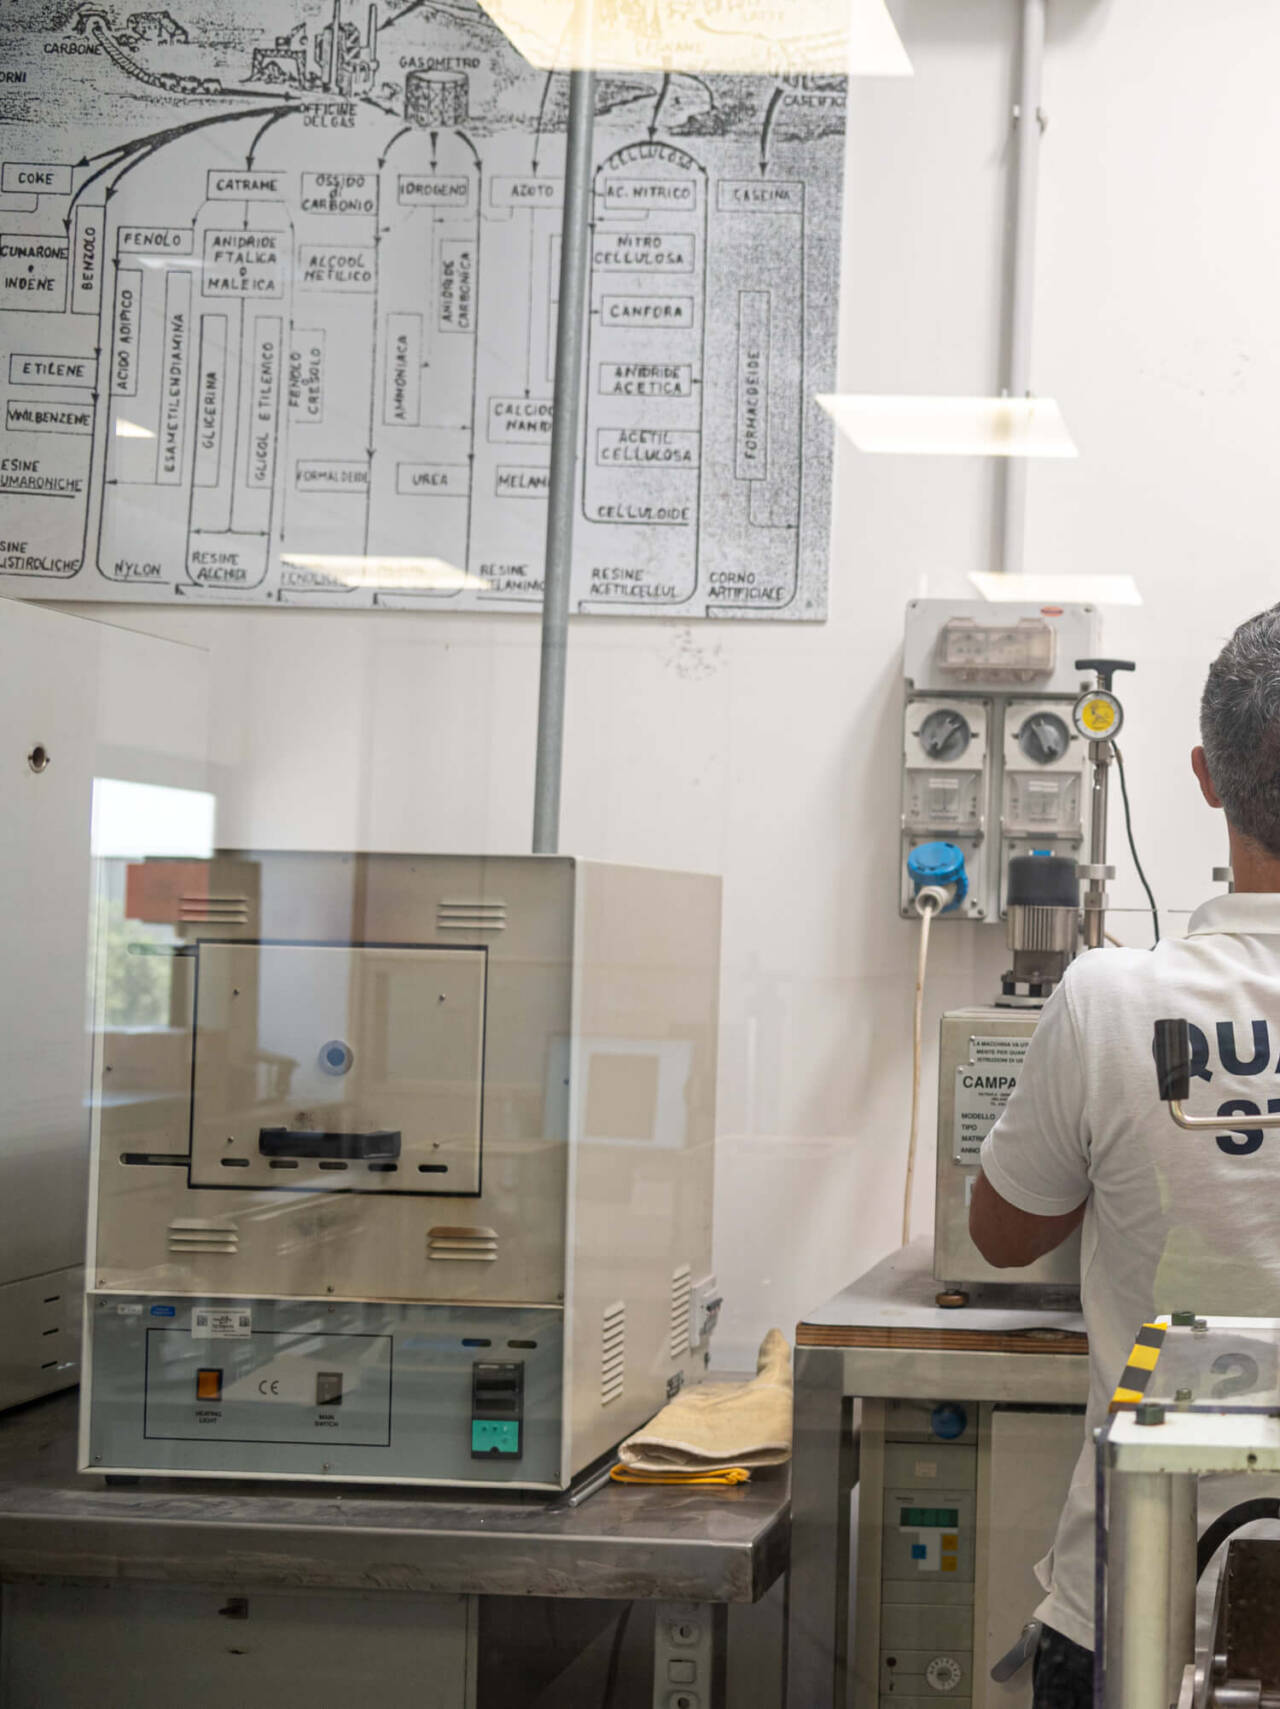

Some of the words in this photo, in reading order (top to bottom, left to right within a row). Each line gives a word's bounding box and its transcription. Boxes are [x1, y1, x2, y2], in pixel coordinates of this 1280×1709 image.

[44, 42, 102, 56] CARBONE
[400, 56, 480, 70] GASOMETRO
[300, 102, 358, 116] OFFICINE
[609, 145, 693, 171] CELLULOSA
[18, 171, 55, 185] COKE
[216, 177, 278, 192] CATRAME
[315, 174, 366, 188] OSSIDO
[401, 182, 468, 196] IDROGENO
[511, 184, 554, 198] AZOTO
[633, 186, 691, 200] NITRICO
[301, 198, 374, 212] CARBONIO
[124, 229, 182, 247] FENOLO
[212, 235, 276, 249] ANIDRIDE
[617, 236, 662, 248] NITRO
[81, 227, 96, 291] BENZOLO
[213, 250, 277, 264] FTALICA
[309, 254, 366, 268] ALCOOL
[594, 252, 684, 265] CELLULOSA
[304, 269, 372, 282] METILICO
[5, 277, 55, 291] INDENE
[208, 277, 275, 291] MALEICA
[119, 289, 134, 344] ADIPICO
[609, 304, 684, 318] CANFORA
[22, 362, 86, 378] ETILENE
[116, 350, 131, 390] ACIDO
[394, 334, 408, 420] AMMONIACA
[614, 366, 681, 380] ANIDRIDE
[258, 341, 274, 421] ETILENICO
[288, 352, 302, 408] FENOLO
[164, 313, 184, 473] ESAMETILENDIAMINA
[613, 381, 682, 395] ACETICA
[202, 371, 217, 449] GLICERINA
[618, 430, 673, 445] ACETIL
[254, 432, 270, 481] GLICOL
[601, 446, 692, 462] CELLULOSA
[1, 458, 40, 473] ESINE
[0, 474, 83, 492] UMARONICHE
[412, 472, 448, 486] UREA
[597, 506, 690, 520] CELLULOIDE
[192, 551, 240, 566] RESINE
[115, 561, 161, 576] NYLON
[480, 563, 528, 577] RESINE
[591, 567, 645, 581] RESINE
[709, 571, 756, 584] CORNO
[708, 586, 786, 601] ARTIFICIALE
[961, 1112, 996, 1121] MODELLO
[961, 1123, 978, 1131] TIPO
[961, 1146, 981, 1154] ANNO
